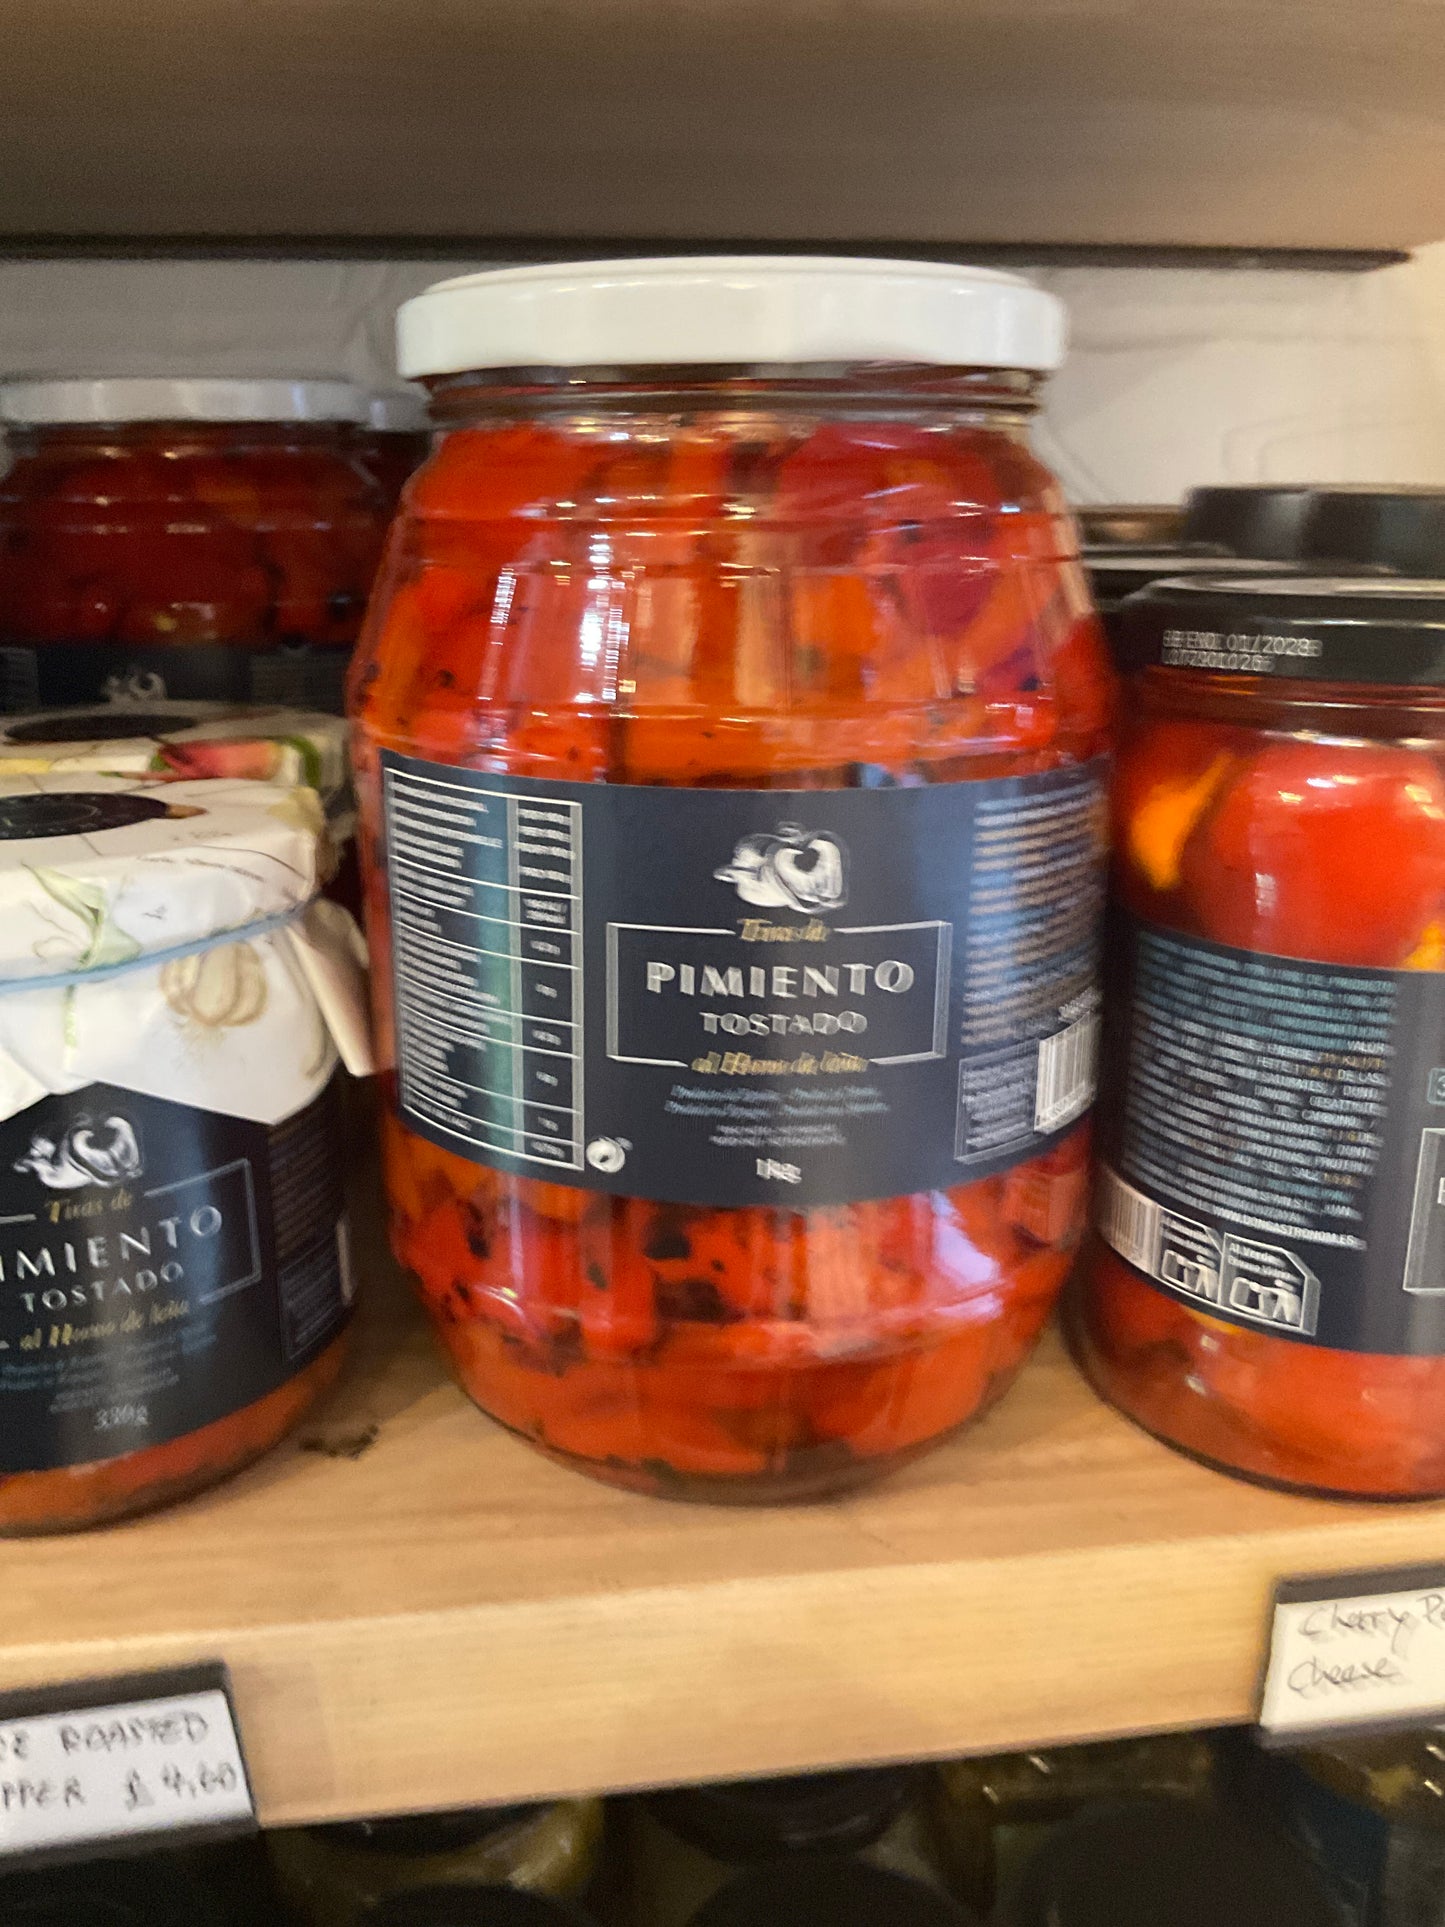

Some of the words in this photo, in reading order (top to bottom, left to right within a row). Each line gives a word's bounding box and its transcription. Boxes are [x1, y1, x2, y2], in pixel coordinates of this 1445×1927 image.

[646, 959, 915, 998] PIMIENTO
[700, 1010, 868, 1036] TOSTADO
[19, 1261, 185, 1313] TOSTADO
[1416, 1593, 1445, 1627] P
